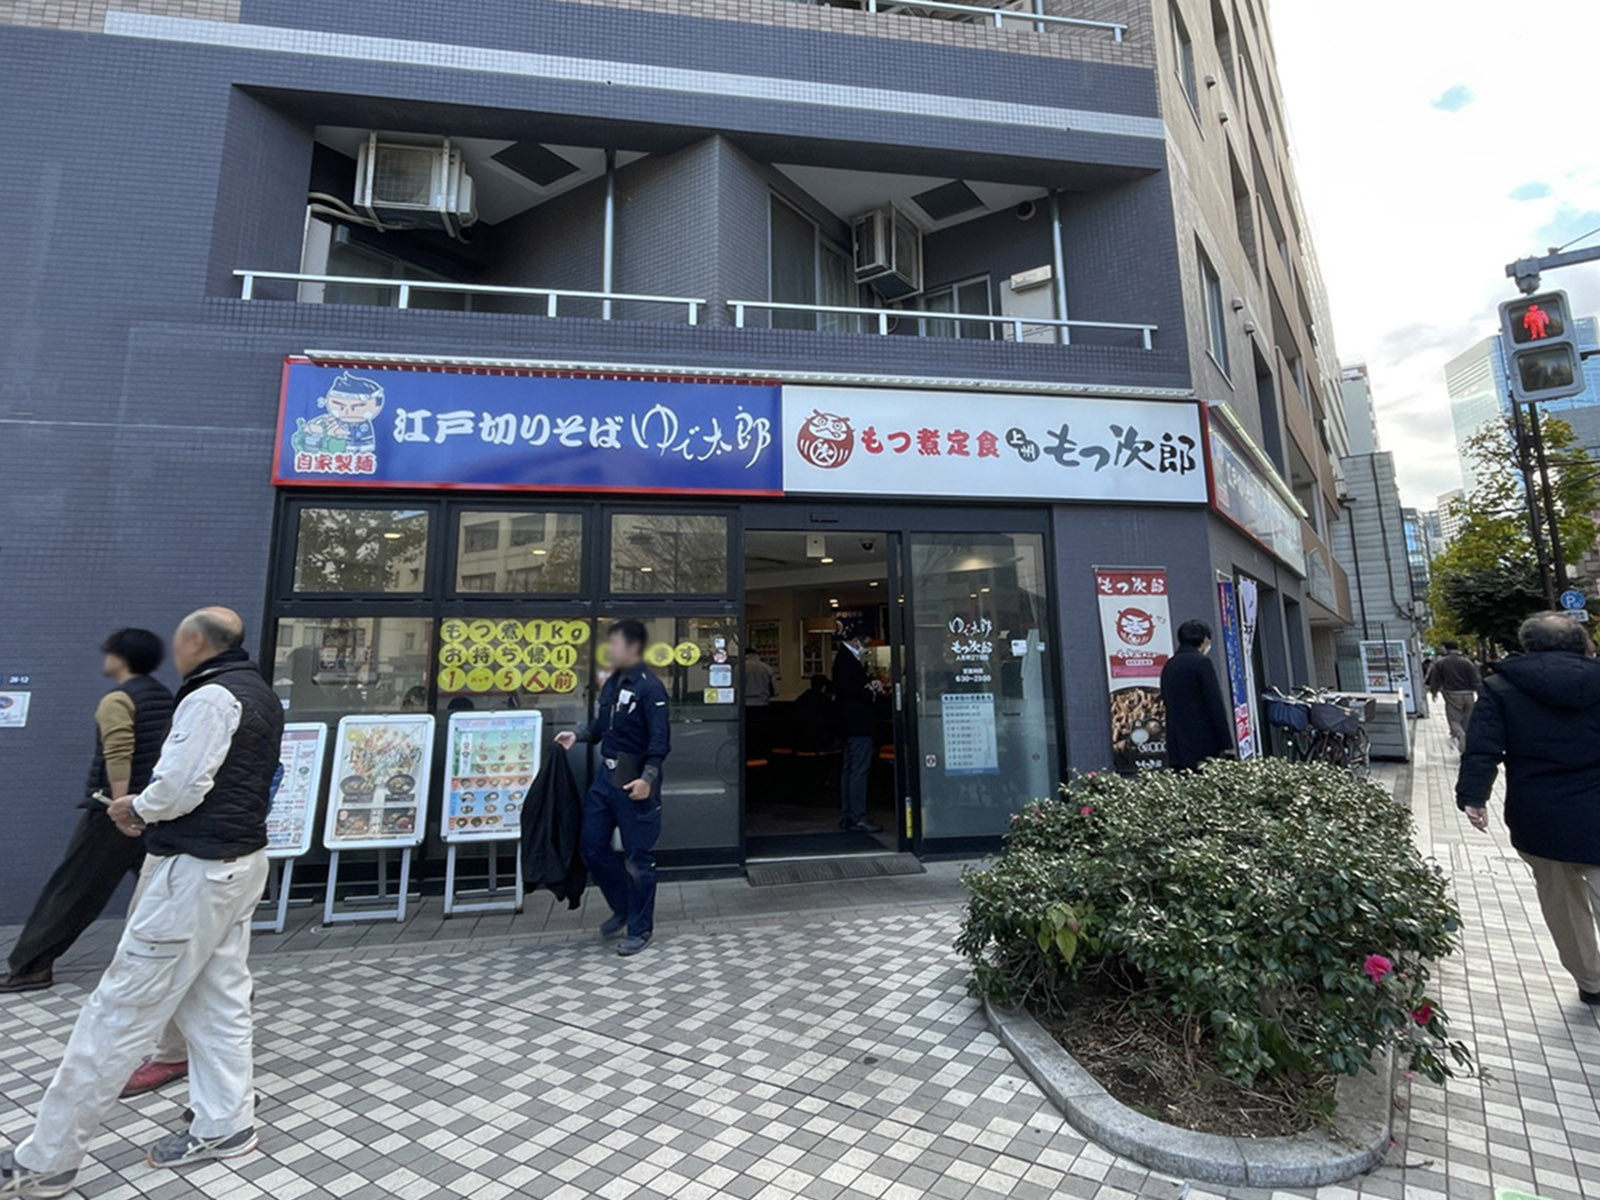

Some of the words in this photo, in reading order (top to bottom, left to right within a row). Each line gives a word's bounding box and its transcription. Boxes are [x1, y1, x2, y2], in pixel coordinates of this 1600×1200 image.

[393, 407, 624, 450] 江戸切りそば
[631, 403, 772, 469] ゆで太郎
[861, 425, 1000, 459] もつ煮定食
[1043, 423, 1197, 476] もつ次郎
[296, 452, 375, 473] 自家製麺
[1100, 577, 1164, 593] もつ次郎
[444, 647, 571, 665] お持ち帰り
